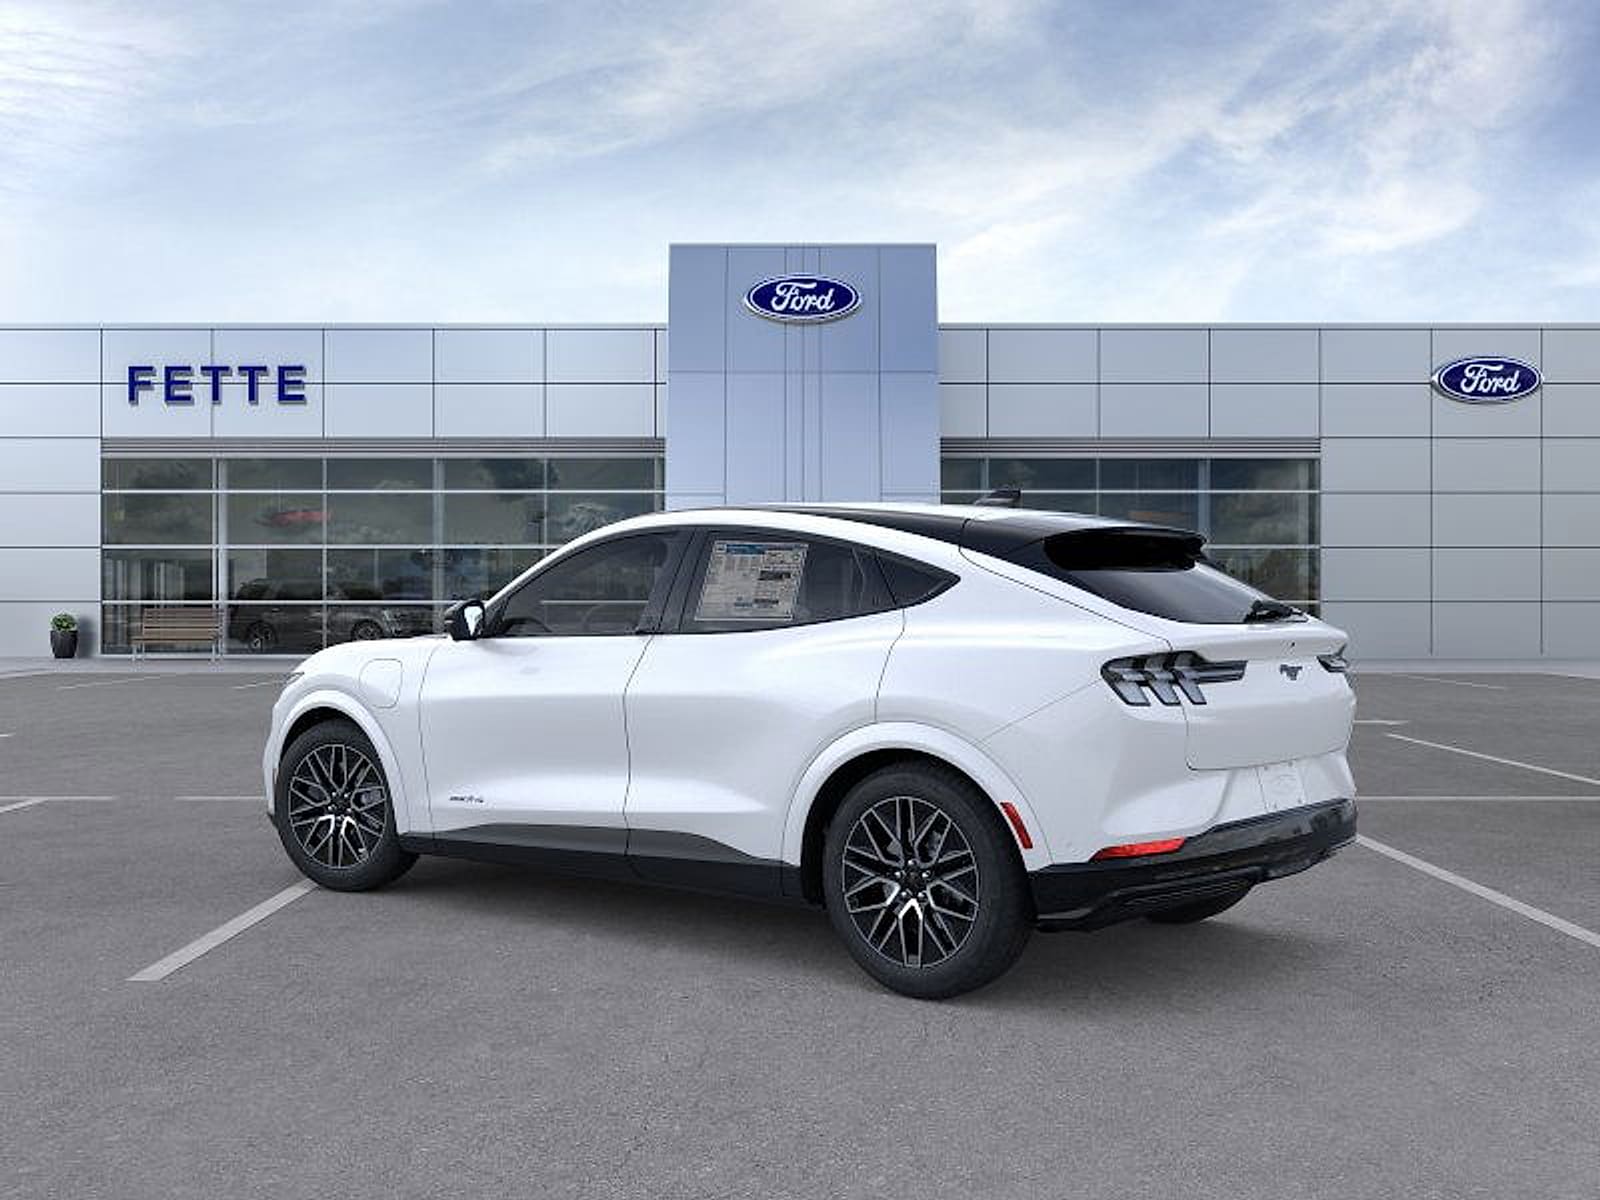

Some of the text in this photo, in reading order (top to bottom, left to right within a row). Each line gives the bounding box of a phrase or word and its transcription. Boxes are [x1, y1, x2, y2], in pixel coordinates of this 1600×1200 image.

[771, 282, 835, 311] Ford
[128, 366, 306, 403] FETTE
[1460, 364, 1521, 393] Ford
